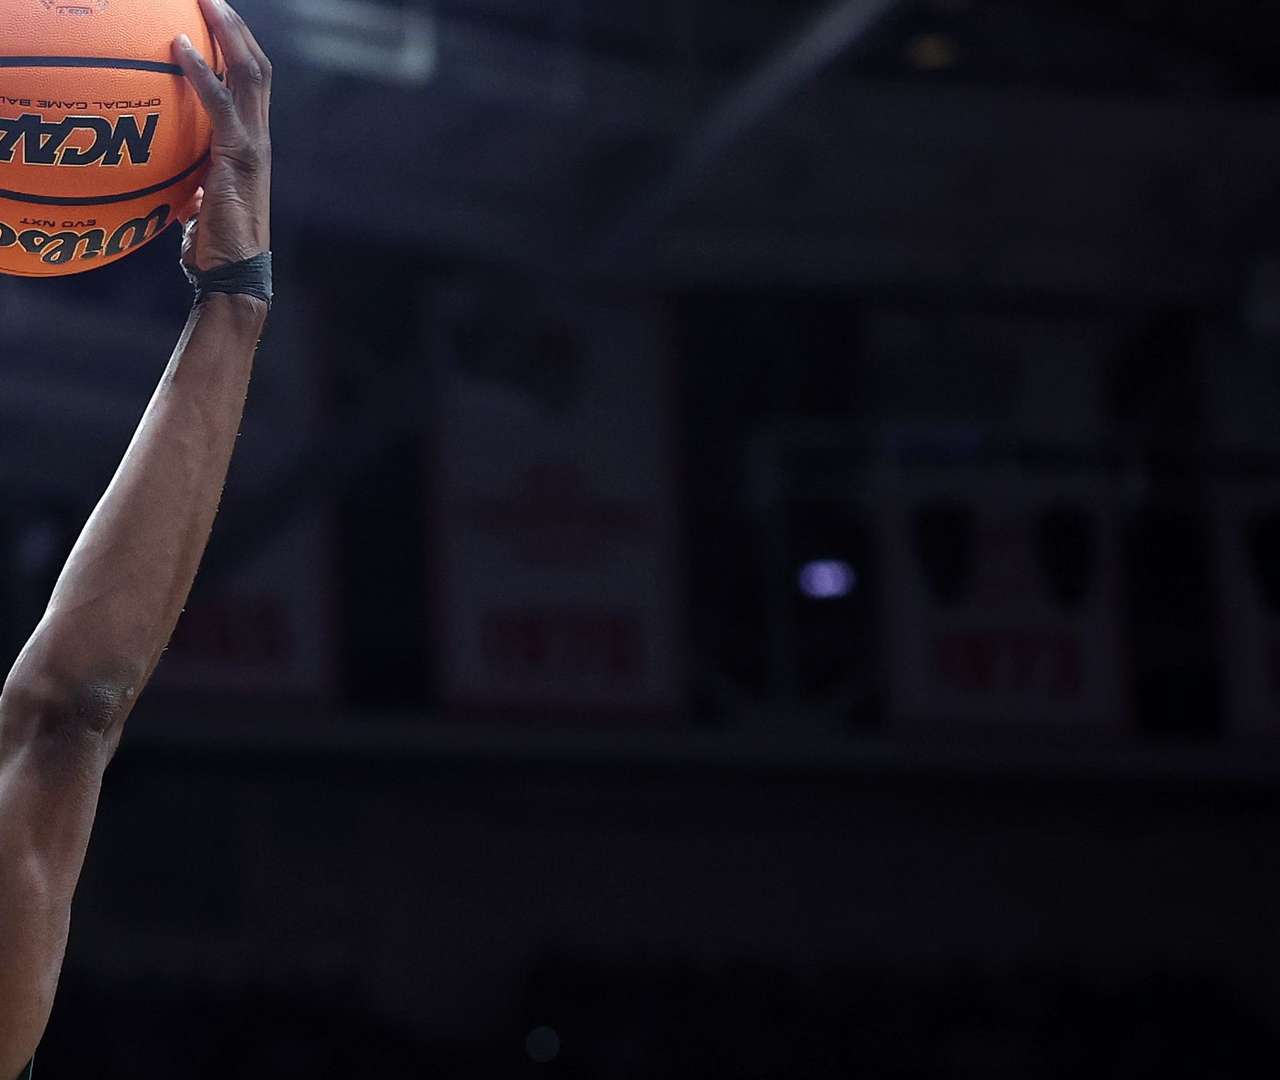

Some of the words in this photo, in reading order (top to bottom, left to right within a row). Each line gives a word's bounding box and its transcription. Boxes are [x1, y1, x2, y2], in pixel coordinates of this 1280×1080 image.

[36, 98, 88, 110] GAME
[91, 98, 162, 110] OFFICIAL
[18, 216, 57, 228] NXT
[61, 218, 97, 229] EVO
